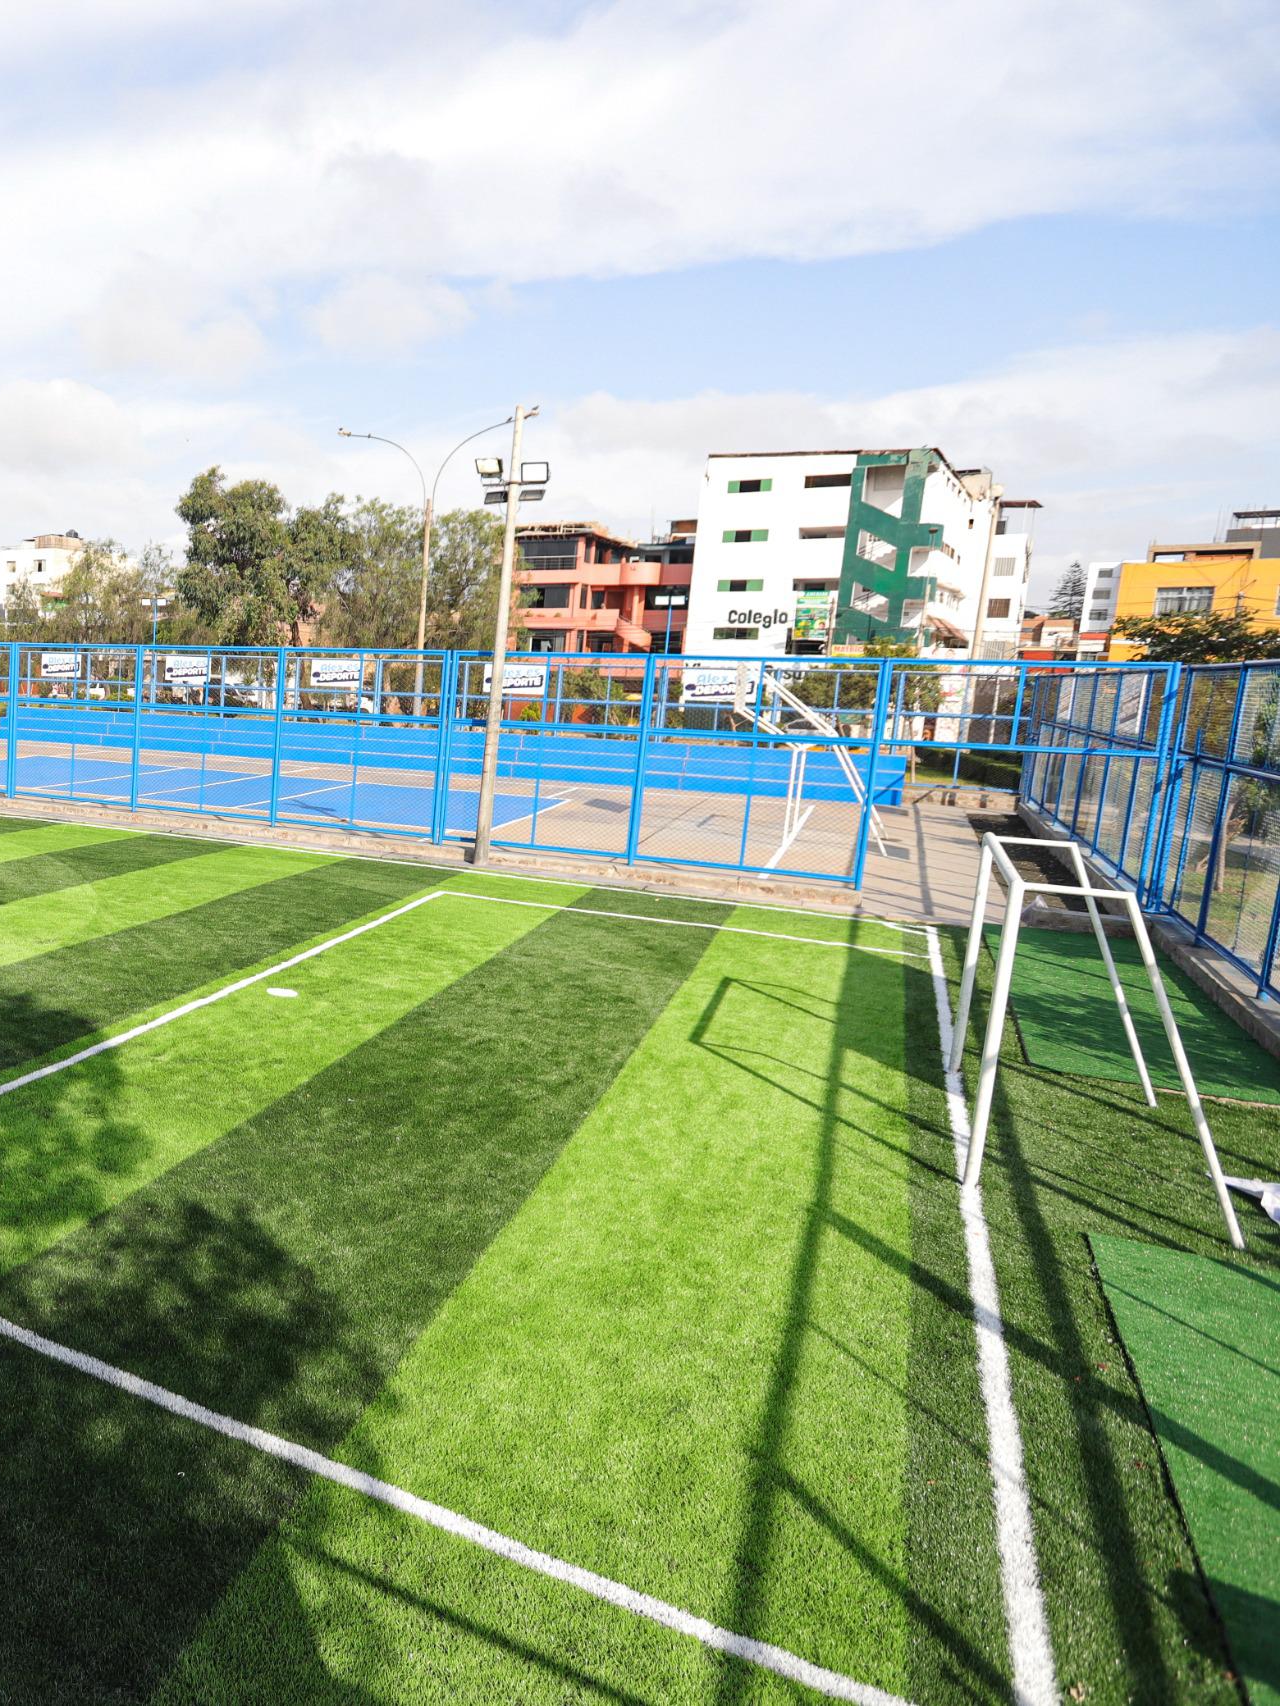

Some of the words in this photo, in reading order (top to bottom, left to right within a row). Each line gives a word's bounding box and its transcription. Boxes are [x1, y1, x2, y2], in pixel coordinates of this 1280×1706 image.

[48, 663, 79, 672] DEPORT
[319, 671, 360, 681] DEPORTE
[502, 676, 541, 687] EPORTE
[697, 673, 728, 684] Alex
[696, 684, 752, 695] DEPORE
